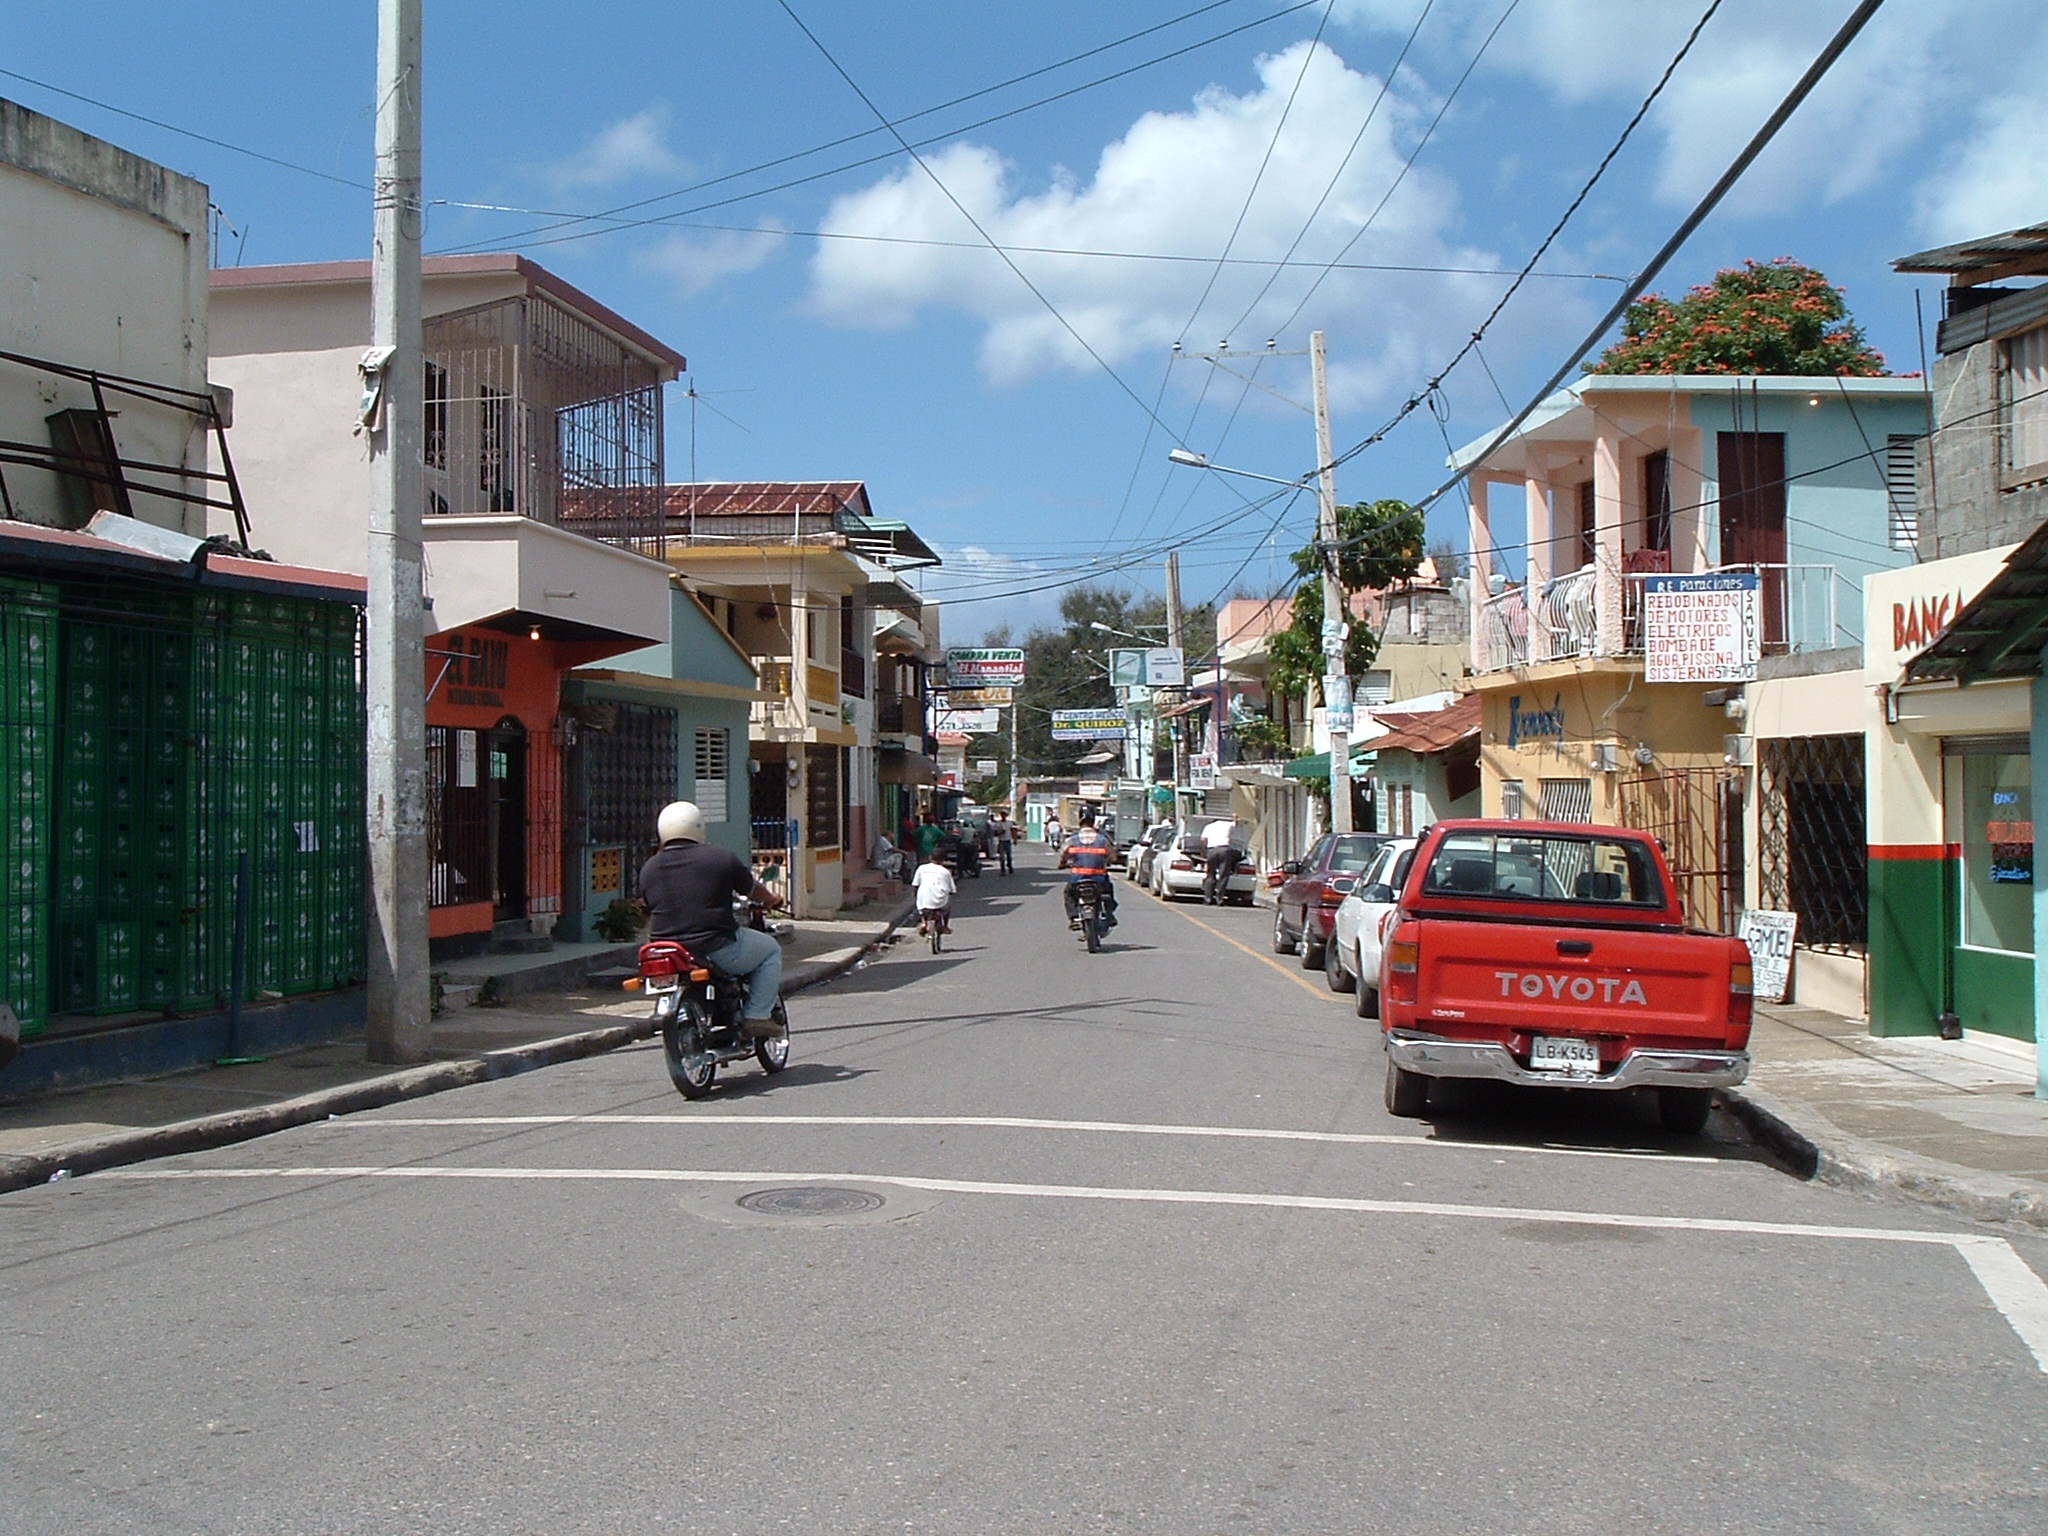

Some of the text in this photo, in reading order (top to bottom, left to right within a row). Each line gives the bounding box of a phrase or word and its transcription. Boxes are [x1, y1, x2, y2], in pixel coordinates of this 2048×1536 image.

[1648, 594, 1739, 608] REBOBINADOS
[1648, 609, 1729, 623] DE MOTORES
[1647, 623, 1733, 638] ELECTRICOS
[1745, 590, 1755, 662] SAMUEL
[1648, 638, 1717, 653] BOMBA DE
[991, 650, 1022, 661] VENTA
[1053, 719, 1124, 729] Dr. QUIROZ
[1495, 972, 1647, 1006] TOYOTA
[1536, 1044, 1594, 1062] LB-K545
